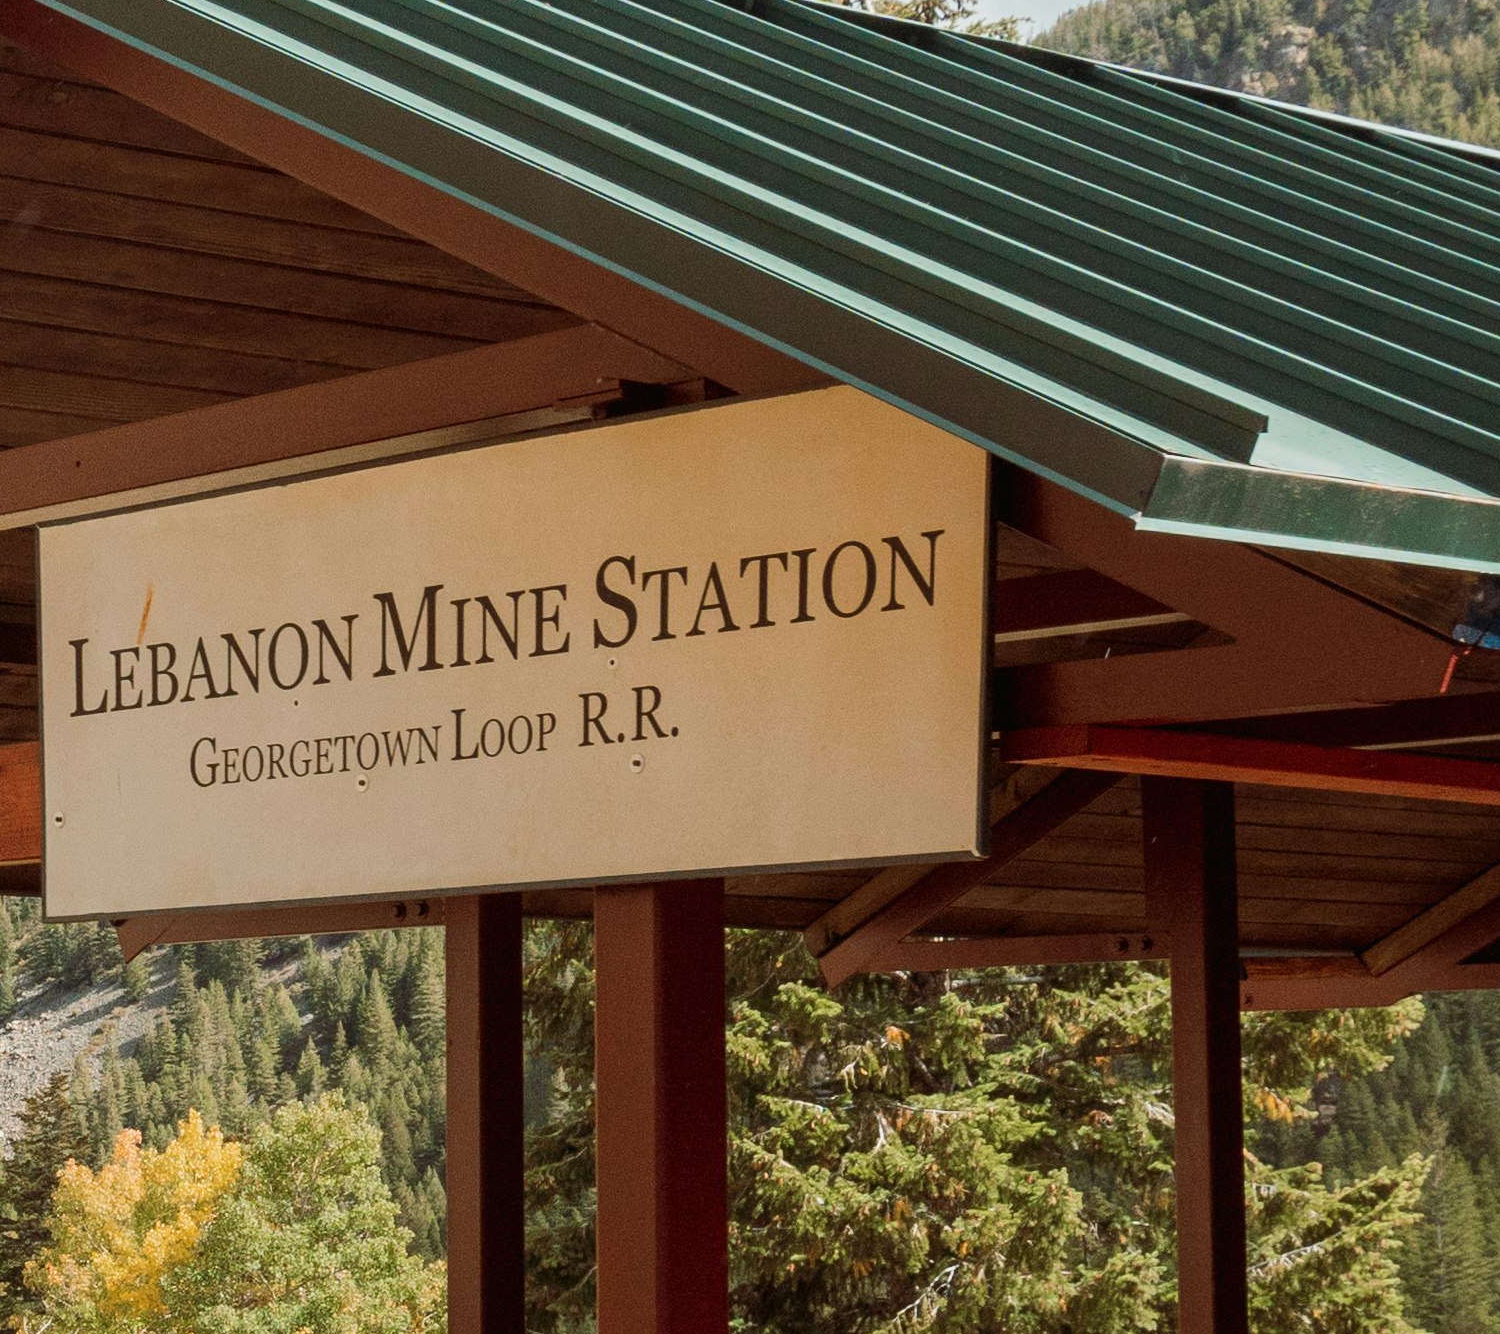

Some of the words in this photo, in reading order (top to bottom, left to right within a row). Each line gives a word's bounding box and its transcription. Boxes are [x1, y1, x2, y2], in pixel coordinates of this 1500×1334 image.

[68, 613, 360, 718] LEBANON
[372, 583, 571, 678] MINE
[593, 529, 945, 650] STATION
[189, 724, 442, 788] GEORGETOWN
[451, 708, 558, 762] LOOP
[577, 685, 680, 748] R.R.
